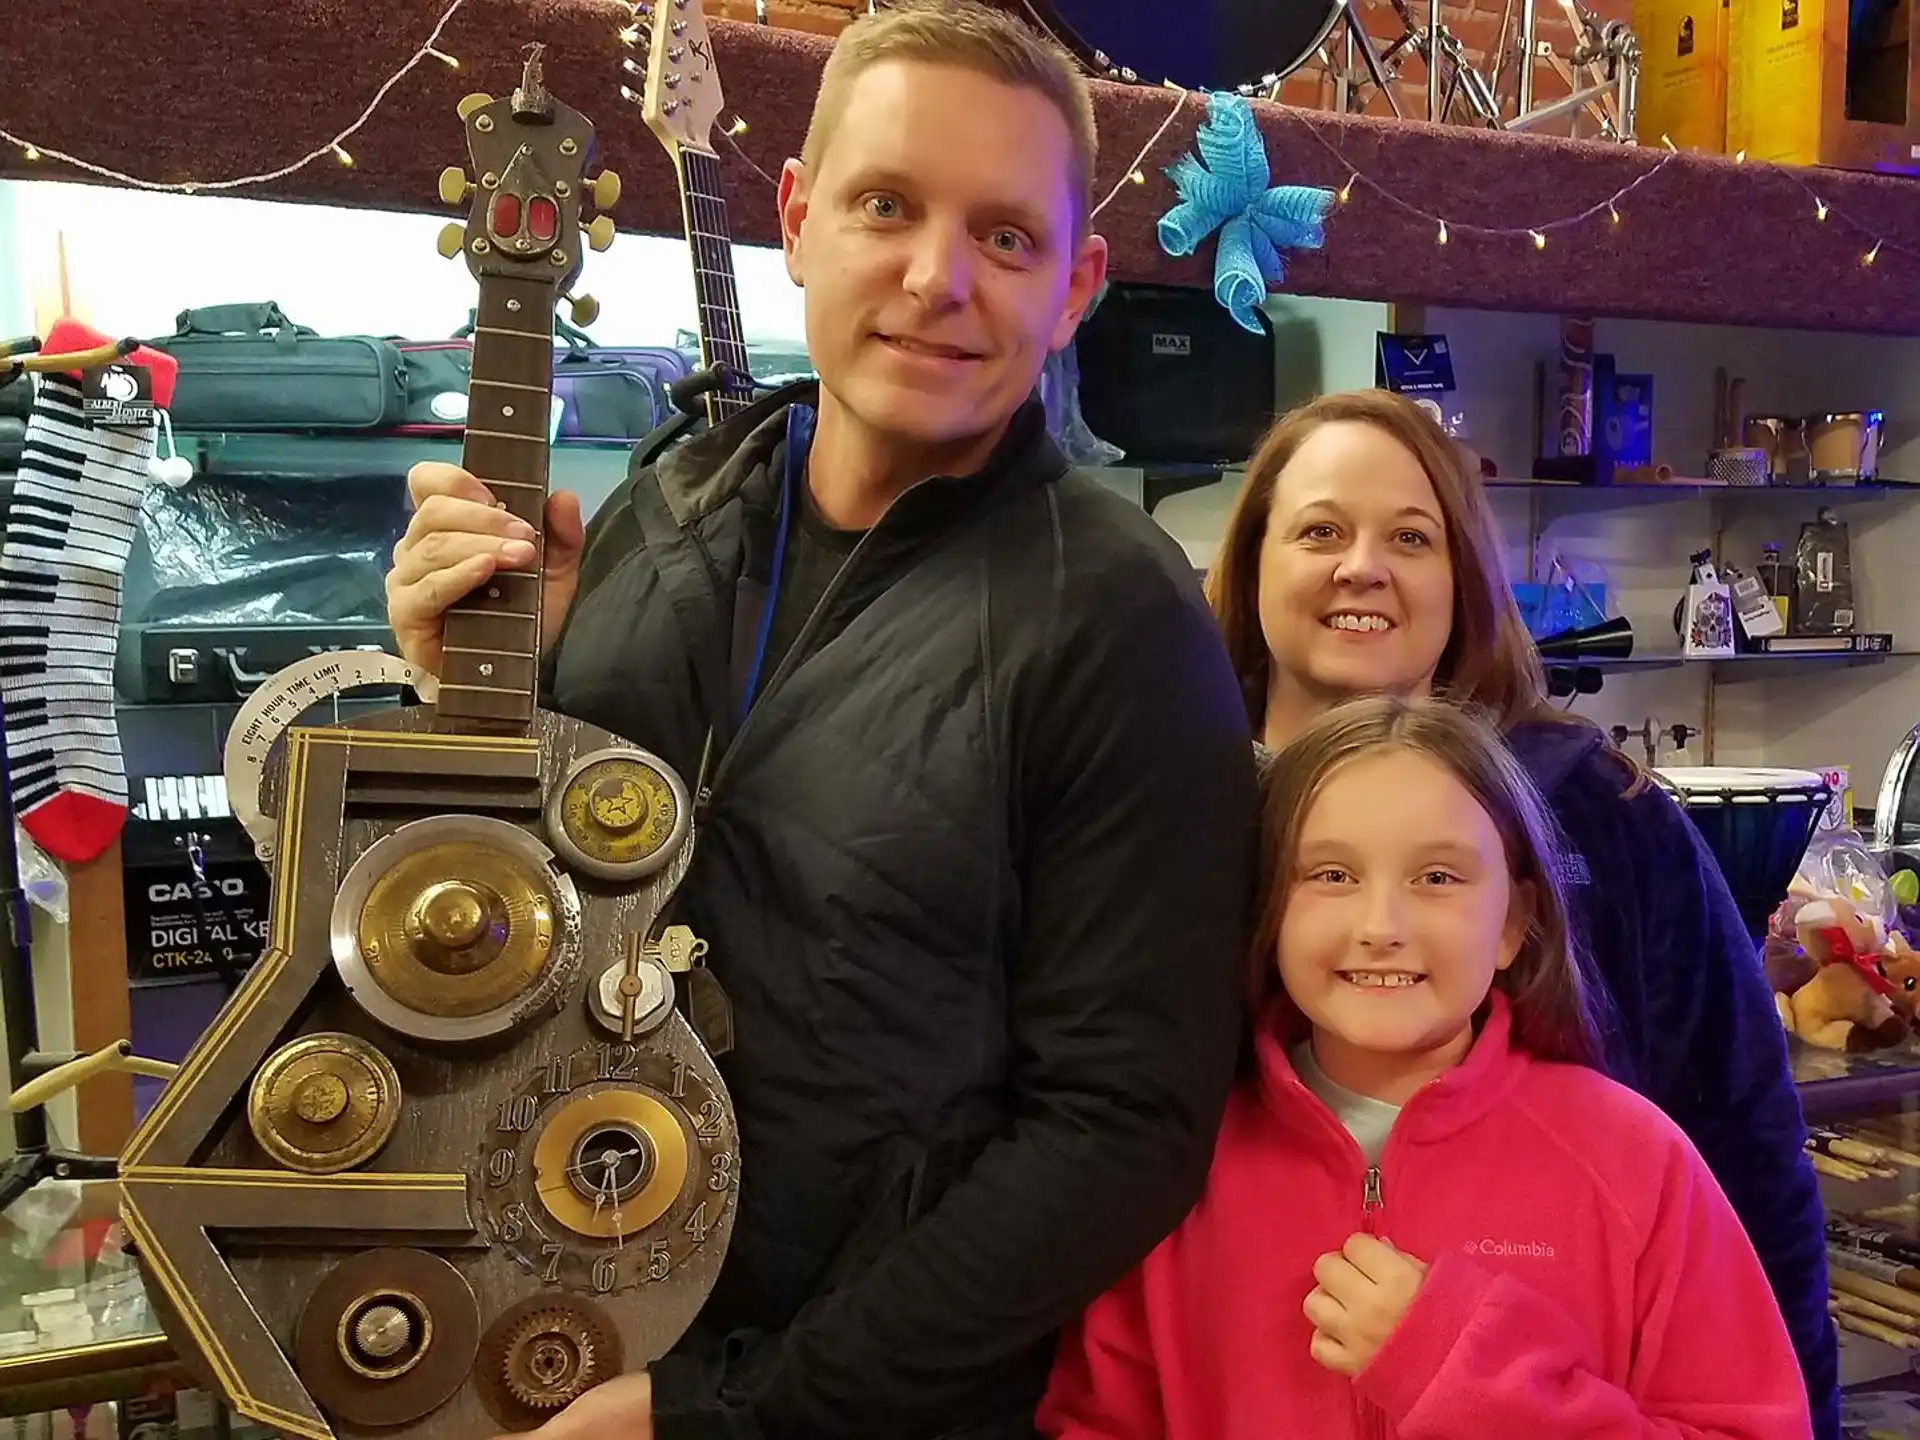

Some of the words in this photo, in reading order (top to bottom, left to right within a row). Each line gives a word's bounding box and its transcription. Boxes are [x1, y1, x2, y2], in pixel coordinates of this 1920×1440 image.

[1155, 336, 1188, 349] MAX
[241, 718, 263, 746] EIGHT
[261, 694, 287, 718] HOUR
[286, 677, 312, 695] TIME
[313, 663, 342, 681] LIMIT
[247, 755, 257, 764] 8
[256, 734, 267, 744] 7
[271, 716, 280, 725] 6
[288, 700, 297, 709] 5
[308, 687, 316, 695] 4
[331, 676, 340, 685] 3
[354, 669, 363, 679] 2
[380, 667, 386, 676] 1
[404, 669, 412, 678] 0
[148, 878, 245, 902] CASO
[151, 924, 238, 948] DIGIAL
[152, 947, 234, 968] CTK-240
[543, 1055, 575, 1094] 11
[596, 1042, 639, 1080] 12
[669, 1061, 689, 1098] 1
[497, 1094, 538, 1132] 10
[698, 1100, 725, 1139] 2
[489, 1149, 516, 1187] 9
[708, 1151, 733, 1191] 3
[502, 1204, 525, 1242] 8
[683, 1201, 708, 1243] 4
[542, 1243, 565, 1283] 7
[648, 1238, 672, 1280] 5
[1479, 1238, 1555, 1258] Columbia
[591, 1254, 617, 1292] 6
